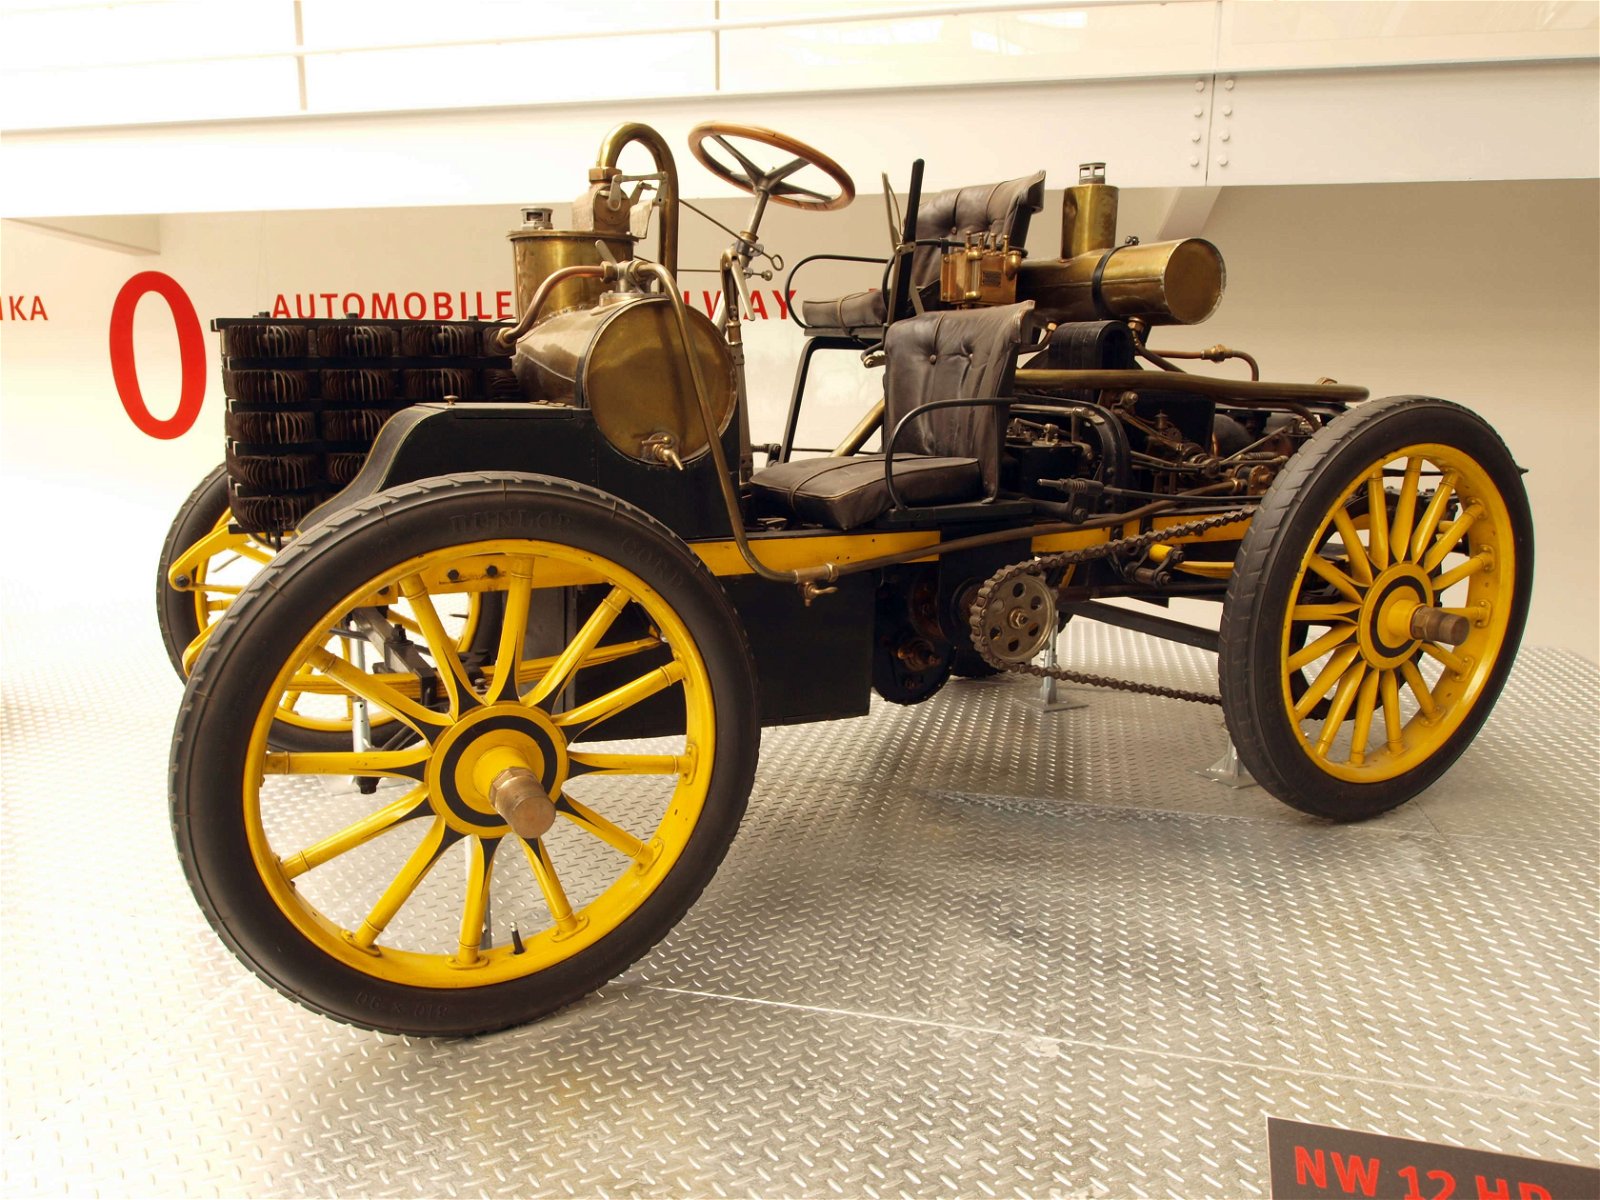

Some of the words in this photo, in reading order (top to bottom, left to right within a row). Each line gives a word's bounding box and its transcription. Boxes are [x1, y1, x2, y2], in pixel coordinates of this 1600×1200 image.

[449, 509, 576, 533] DUNLOP
[1295, 1146, 1381, 1197] NW
[1398, 1165, 1457, 1200] 12
